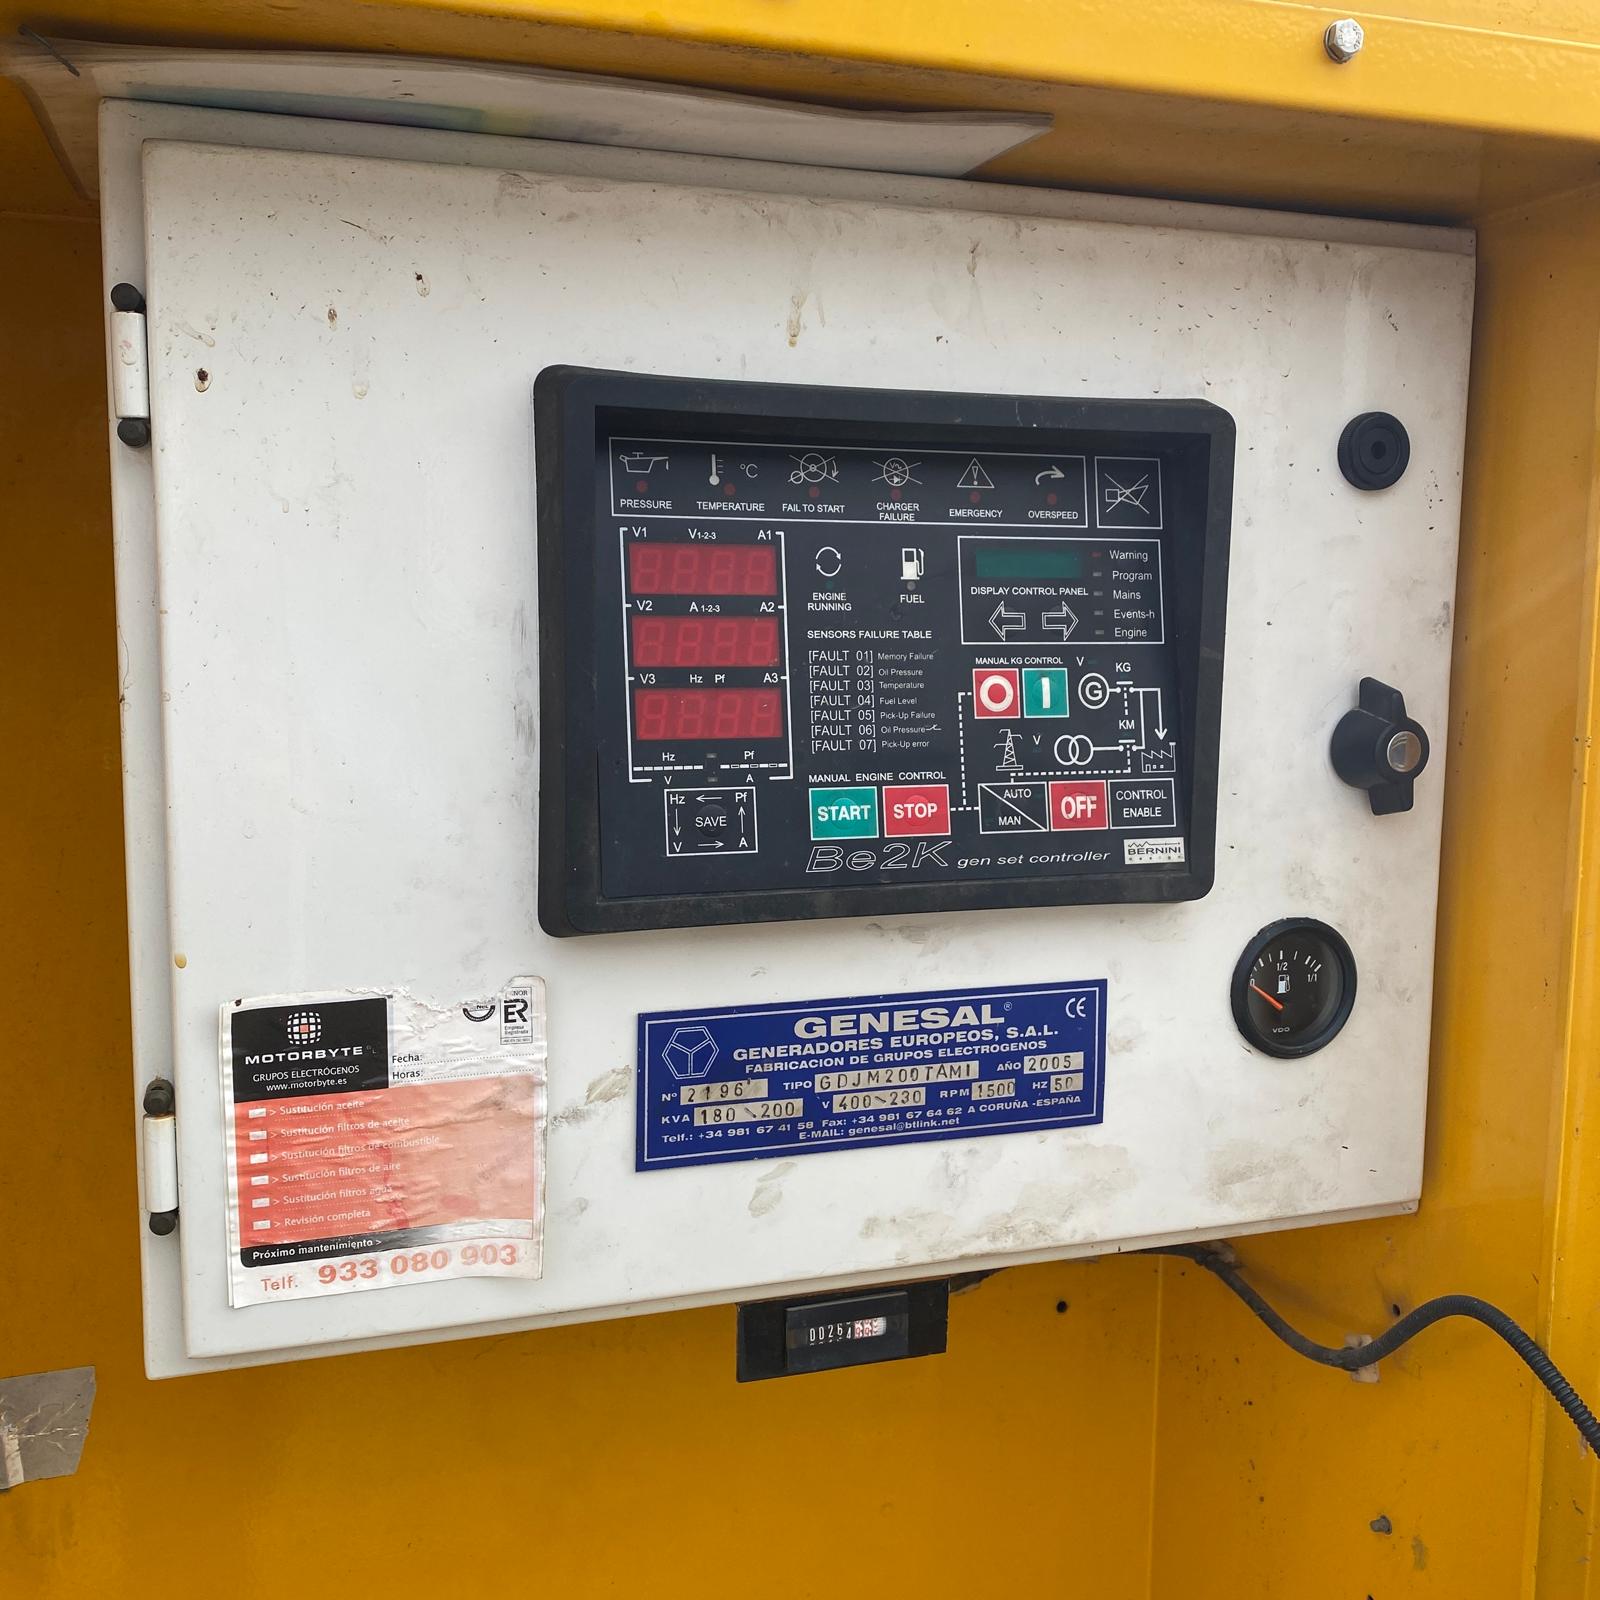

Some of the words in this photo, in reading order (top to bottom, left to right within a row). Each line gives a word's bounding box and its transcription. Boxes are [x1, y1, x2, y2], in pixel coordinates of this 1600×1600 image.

[619, 499, 673, 510] PRESSURE
[697, 501, 765, 512] TEMPERATURE
[782, 503, 800, 512] FAIL
[802, 503, 815, 512] TO
[816, 504, 846, 514] START
[876, 502, 920, 511] CHARGER
[879, 512, 915, 521] FAILURE
[949, 508, 1003, 518] EMERGENCY
[1028, 510, 1079, 520] OVERSPEED
[632, 527, 647, 538] V1
[757, 529, 772, 540] A1
[1109, 549, 1149, 562] Warning
[1112, 570, 1153, 582] Program
[812, 592, 847, 601] ENGINE
[970, 586, 1009, 596] DISPLAY
[1011, 587, 1058, 596] CONTROL
[1059, 587, 1089, 596] PANEL
[1113, 589, 1141, 600] Mains
[900, 594, 925, 604] FUEL
[636, 600, 653, 611] V2
[759, 602, 775, 612] A2
[807, 602, 852, 612] RUNNING
[1113, 609, 1155, 620] Events-h
[807, 630, 857, 639] SENSORS
[858, 630, 900, 639] FAILURE
[901, 631, 932, 639] TABLE
[1114, 627, 1147, 639] Engine
[808, 650, 850, 664] [FAULT
[856, 650, 874, 663] 01]
[878, 653, 907, 663] Memory
[909, 652, 934, 660] Failure
[975, 657, 1009, 665] MANUAL
[1010, 657, 1023, 665] KG
[1024, 657, 1063, 665] CONTROL
[809, 665, 850, 678] [FAULT
[856, 665, 874, 678] 02]
[878, 668, 889, 676] Oil
[891, 668, 923, 676] Pressure
[1115, 662, 1131, 673] KG
[639, 673, 656, 684] V3
[689, 674, 703, 683] Hz
[714, 674, 726, 683] Pf
[763, 673, 779, 683] A3
[809, 680, 850, 693] [FAULT
[857, 680, 874, 693] 03]
[879, 682, 924, 690] Temperature
[810, 695, 851, 708] [FAULT
[857, 695, 875, 708] 04]
[879, 697, 897, 705] Fuel
[898, 697, 918, 705] Level
[811, 710, 851, 723] [FAULT
[857, 710, 875, 722] 05]
[880, 712, 909, 720] Pick-Up
[910, 711, 936, 719] Failure
[811, 725, 852, 738] [FAULT
[858, 725, 876, 737] 06]
[881, 726, 892, 734] Oil
[893, 726, 926, 734] Pressure
[811, 740, 853, 754] [FAULT
[859, 739, 877, 753] 07]
[881, 740, 911, 748] Pick-Up
[808, 774, 851, 783] MANUAL
[855, 772, 894, 782] ENGINE
[898, 771, 947, 781] CONTROL
[1003, 788, 1032, 799] AUTO
[1115, 789, 1167, 801] CONTROL
[817, 805, 871, 822] START
[893, 803, 938, 820] STOP
[1060, 795, 1097, 820] OFF
[1123, 807, 1162, 818] ENABLE
[695, 816, 727, 827] SAVE
[998, 815, 1021, 826] MAN
[1128, 846, 1181, 855] BERNINI
[806, 841, 952, 873] Be2K
[956, 855, 991, 869] gen
[996, 854, 1024, 865] set
[1028, 851, 1111, 864] controller
[1277, 962, 1288, 971] 1/2
[1307, 974, 1318, 982] 1/1
[794, 1004, 1005, 1039] GENESAL
[733, 1037, 883, 1061] GENERADORES
[890, 1028, 999, 1048] EUROPEOS,
[1006, 1025, 1058, 1039] S.A.L.
[245, 1046, 363, 1065] MOTORBYTE
[392, 1054, 423, 1064] Fecha:
[745, 1056, 844, 1074] FABRICACION
[850, 1055, 869, 1065] DE
[873, 1049, 934, 1063] GRUPOS
[938, 1040, 1047, 1057] ELECTROGENOS
[252, 1071, 289, 1083] GRUPOS
[291, 1064, 360, 1079] ELECTRÓGENOS
[392, 1069, 423, 1079] Horas:
[782, 1081, 812, 1091] TIPO
[997, 1061, 1021, 1072] AÑO
[1028, 1055, 1072, 1072] 2005
[266, 1077, 347, 1092] www.motorbyte.es
[661, 1114, 690, 1125] KVA
[940, 1088, 970, 1098] RPM
[977, 1081, 1015, 1098] 1500
[1032, 1081, 1048, 1090] HZ
[1054, 1076, 1074, 1091] 50
[280, 1101, 334, 1116] Sustitución
[662, 1134, 693, 1144] Telf.:
[698, 1130, 723, 1139] +34
[728, 1128, 750, 1137] 981
[756, 1126, 773, 1134] 67
[778, 1124, 790, 1132] 41
[797, 1121, 814, 1130] 58
[822, 1119, 846, 1128] Fax:
[851, 1116, 874, 1125] +34
[879, 1113, 900, 1122] 981
[906, 1110, 922, 1119] 67
[926, 1109, 943, 1117] 64
[947, 1107, 962, 1115] 62
[967, 1105, 976, 1113] A
[979, 1099, 1028, 1112] CORUÑA
[280, 1122, 335, 1138] Sustitución
[338, 1120, 365, 1131] filtros
[367, 1120, 379, 1129] de
[799, 1129, 844, 1140] E-MAIL:
[848, 1117, 960, 1137] genesal@btlink.net
[281, 1145, 336, 1161] Sustitución
[338, 1143, 366, 1156] filtros
[382, 1135, 440, 1149] combustible
[282, 1168, 336, 1182] Sustitución
[339, 1166, 366, 1177] filtros
[369, 1163, 381, 1173] de
[383, 1161, 401, 1171] aire
[283, 1190, 336, 1205] Sustitución
[339, 1188, 367, 1199] filtros
[284, 1214, 324, 1227] Revisión
[327, 1209, 371, 1223] completa
[252, 1247, 295, 1260] Próximo
[298, 1239, 373, 1254] mantenimiento
[261, 1276, 299, 1292] Telf.
[318, 1258, 378, 1285] 933
[390, 1250, 449, 1275] 080
[460, 1243, 518, 1266] 903
